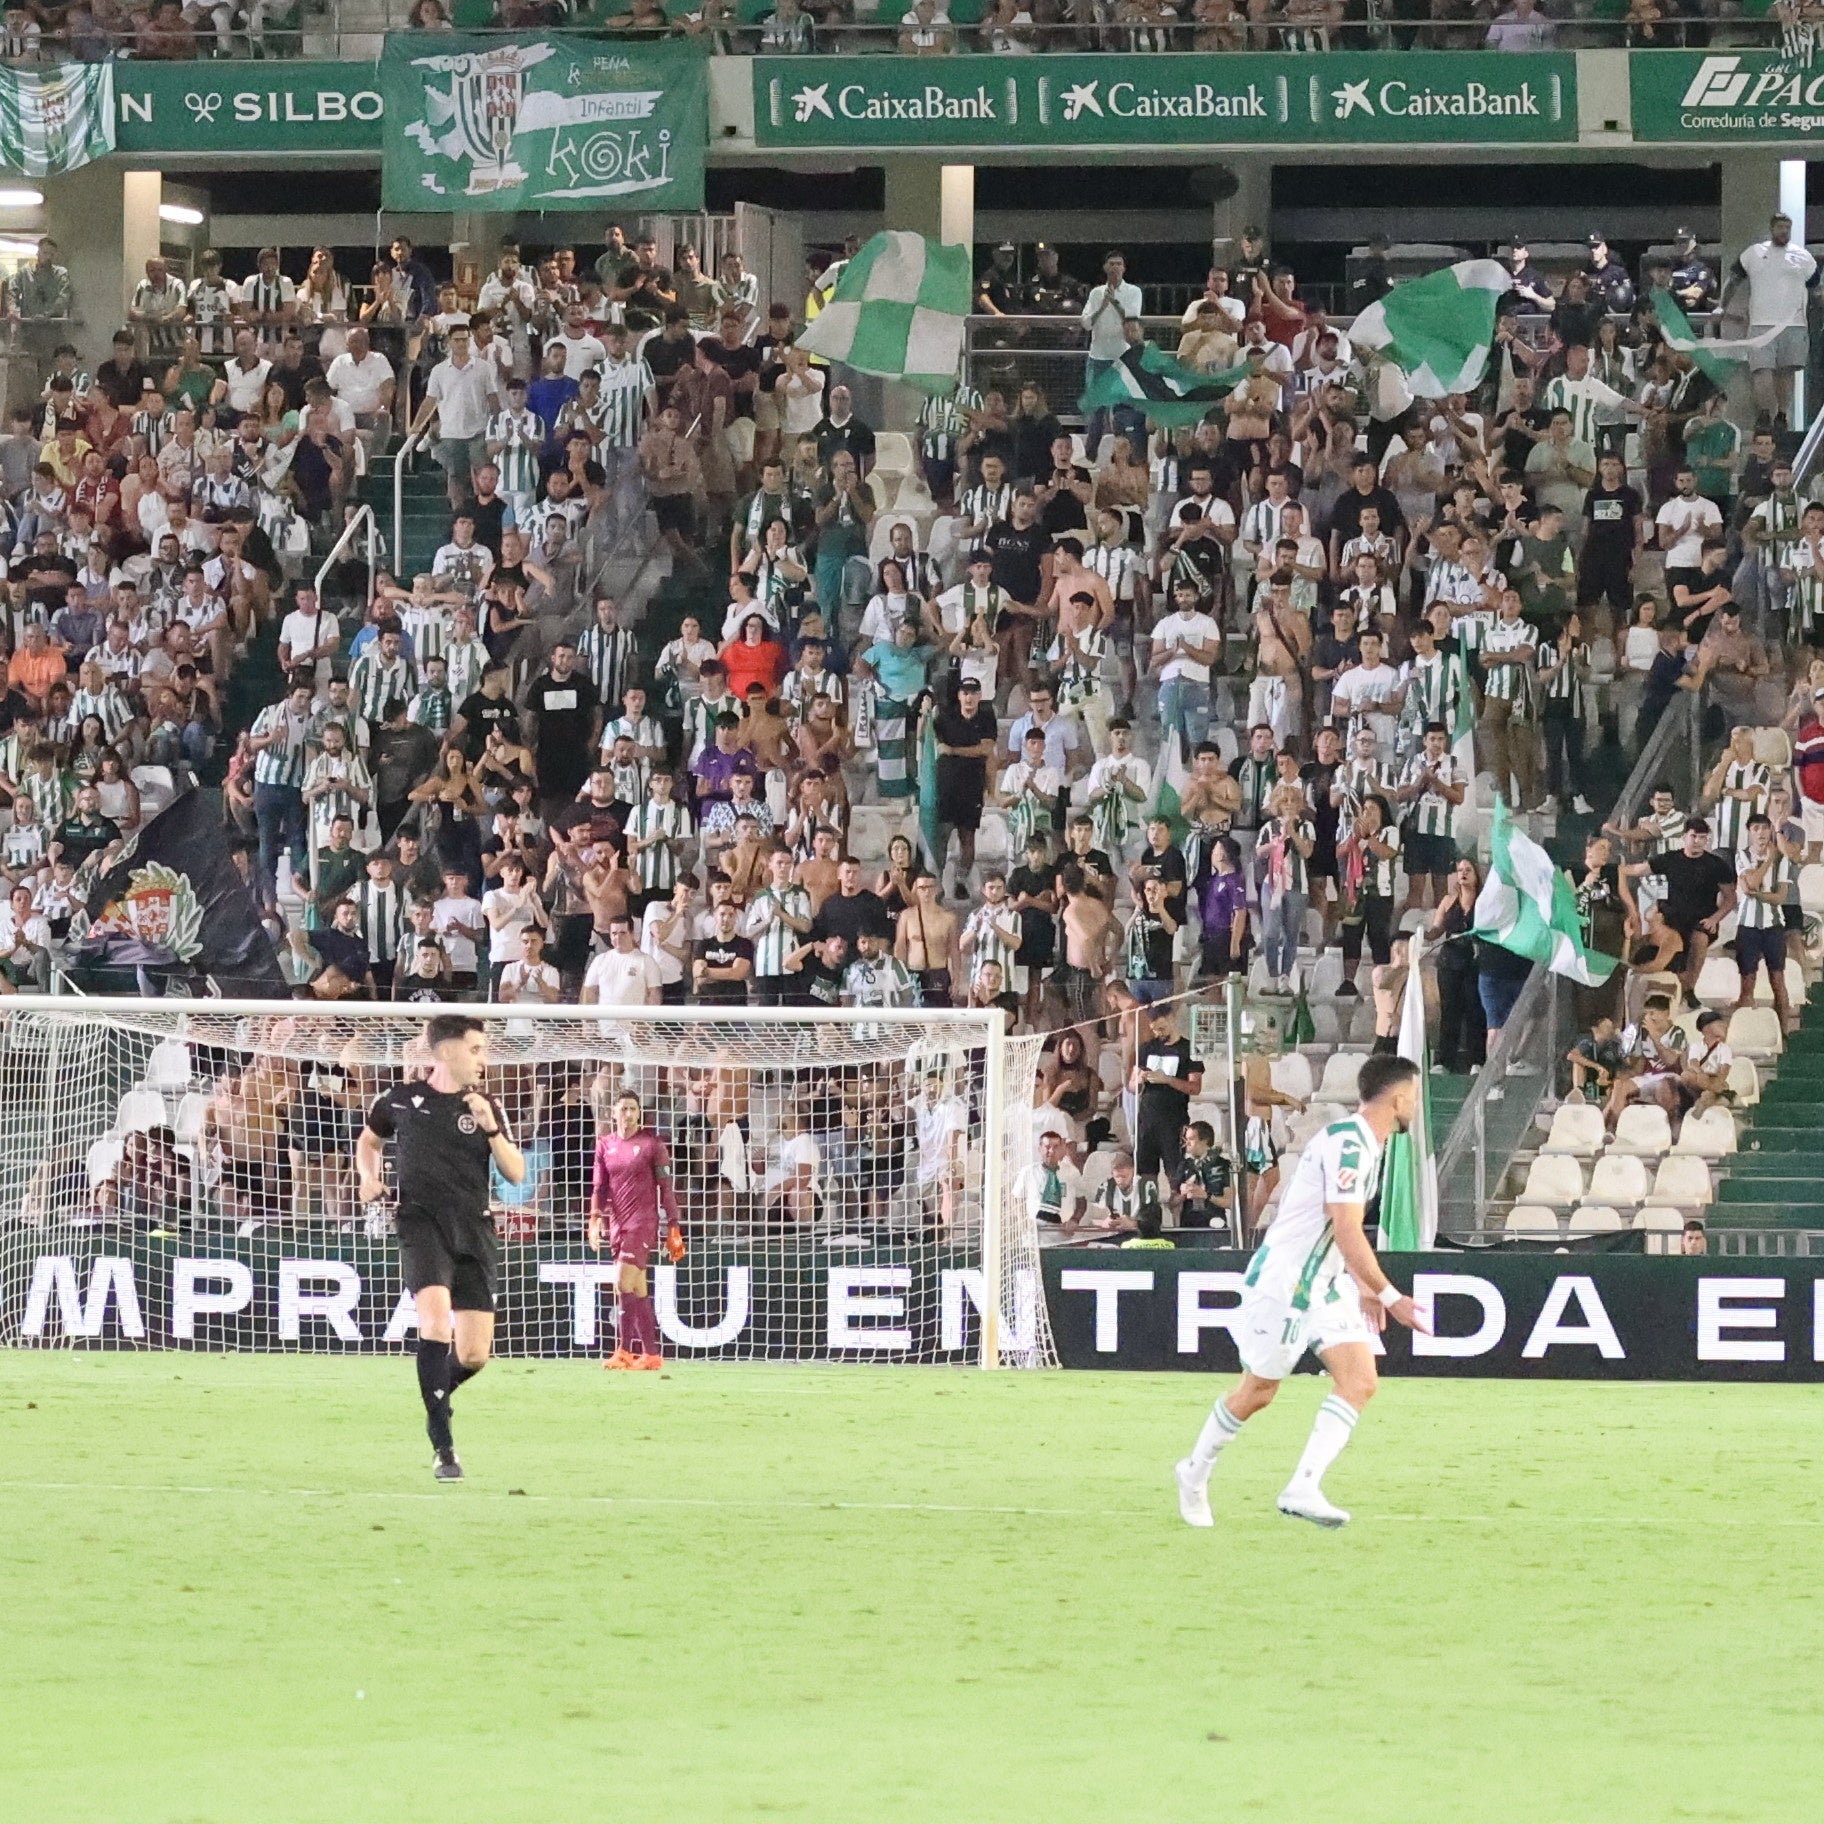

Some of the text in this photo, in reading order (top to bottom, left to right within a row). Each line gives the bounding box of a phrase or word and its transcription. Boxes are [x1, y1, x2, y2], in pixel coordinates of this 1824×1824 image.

[839, 86, 996, 121] CaixaBank
[1107, 83, 1268, 119] CaixaBank
[1378, 81, 1539, 117] CaixaBank
[1758, 112, 1777, 128] de
[539, 1262, 751, 1350] TU
[1280, 1316, 1300, 1345] 10
